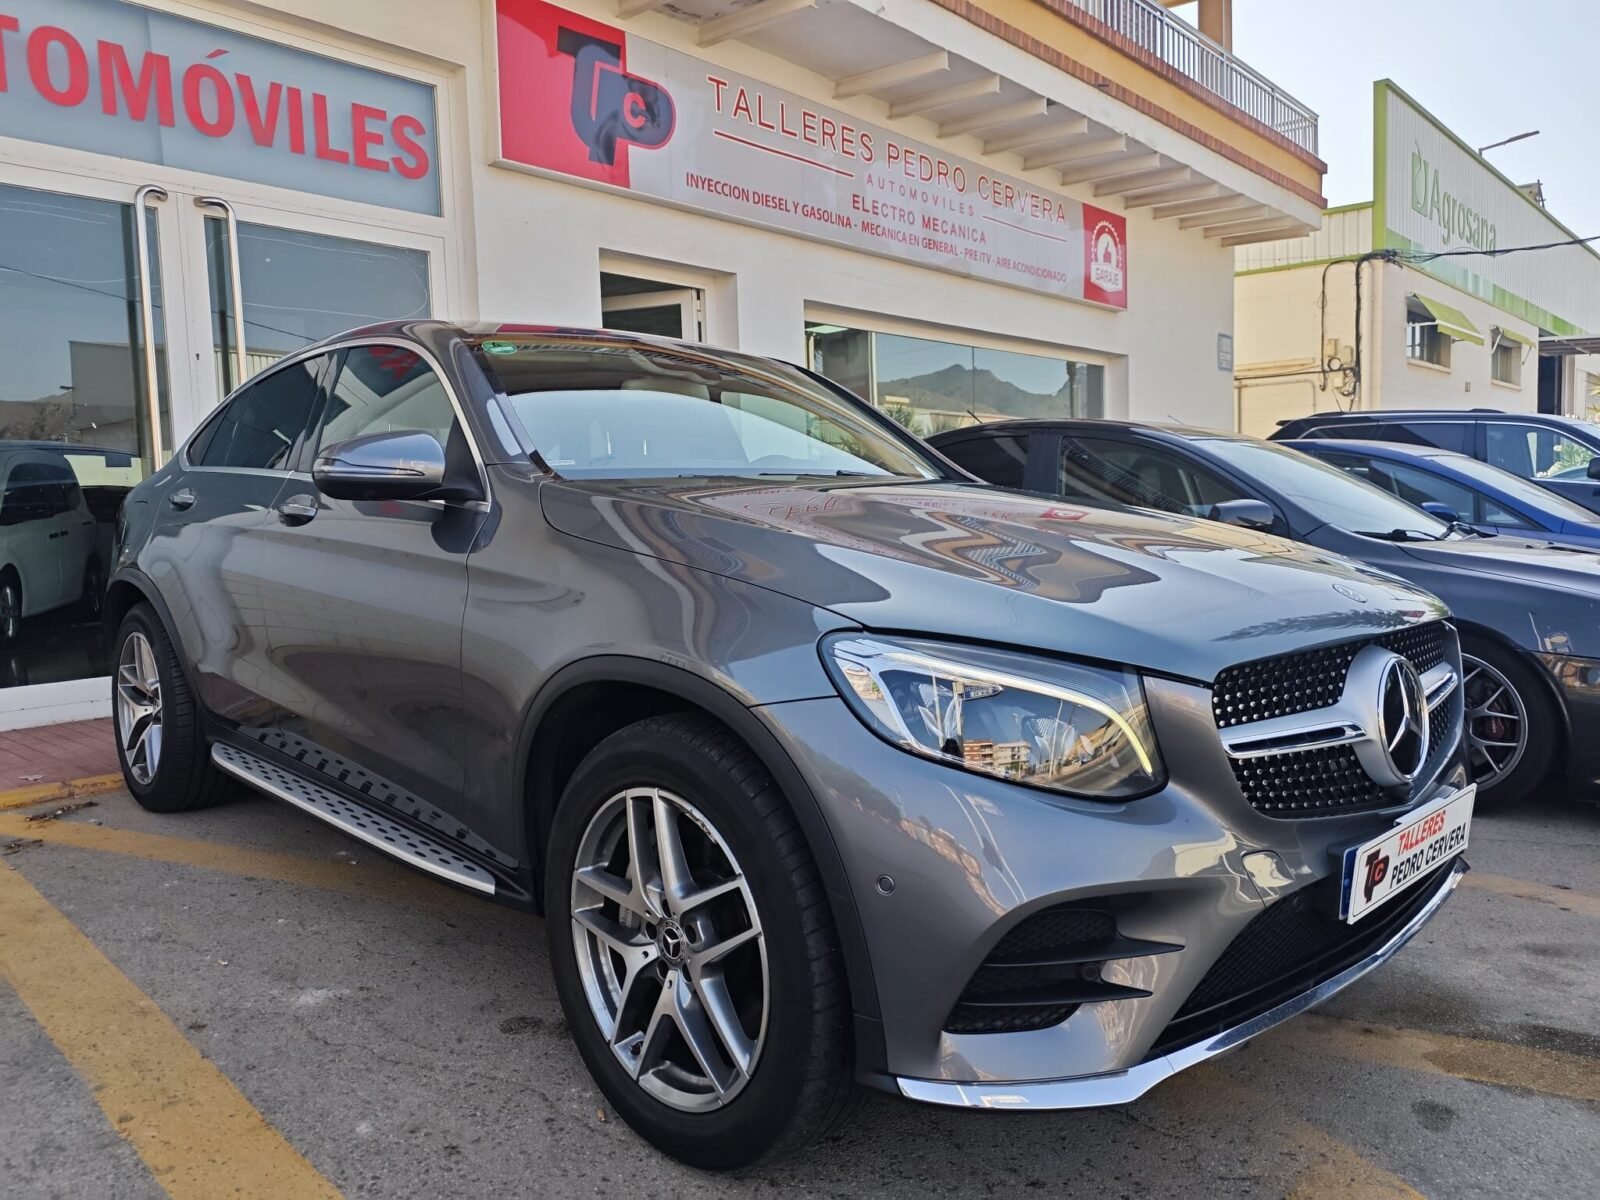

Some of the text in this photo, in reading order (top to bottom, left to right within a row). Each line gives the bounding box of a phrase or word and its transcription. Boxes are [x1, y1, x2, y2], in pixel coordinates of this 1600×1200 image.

[707, 75, 1067, 224] TALLERES PEDRO CERVERA
[852, 193, 987, 245] ELECTRO MECANICA
[866, 173, 975, 217] AUTOMOVILES
[1429, 168, 1497, 257] Agrosana
[685, 172, 750, 203] INYECCION
[752, 191, 790, 213] DIESEL
[792, 200, 800, 214] Y
[801, 204, 852, 229] GASOLINA
[861, 220, 907, 244] MECANICA
[909, 235, 920, 247] EN
[921, 237, 959, 256] GENERAL
[964, 248, 979, 261] PRE
[979, 251, 991, 264] ITV
[996, 256, 1011, 270] AIRE
[1012, 260, 1067, 283] ACONDICIONADO
[1095, 267, 1120, 287] GARAJE
[1390, 822, 1466, 889] PEDRO CERVERA
[1397, 809, 1447, 856] TALLERES
